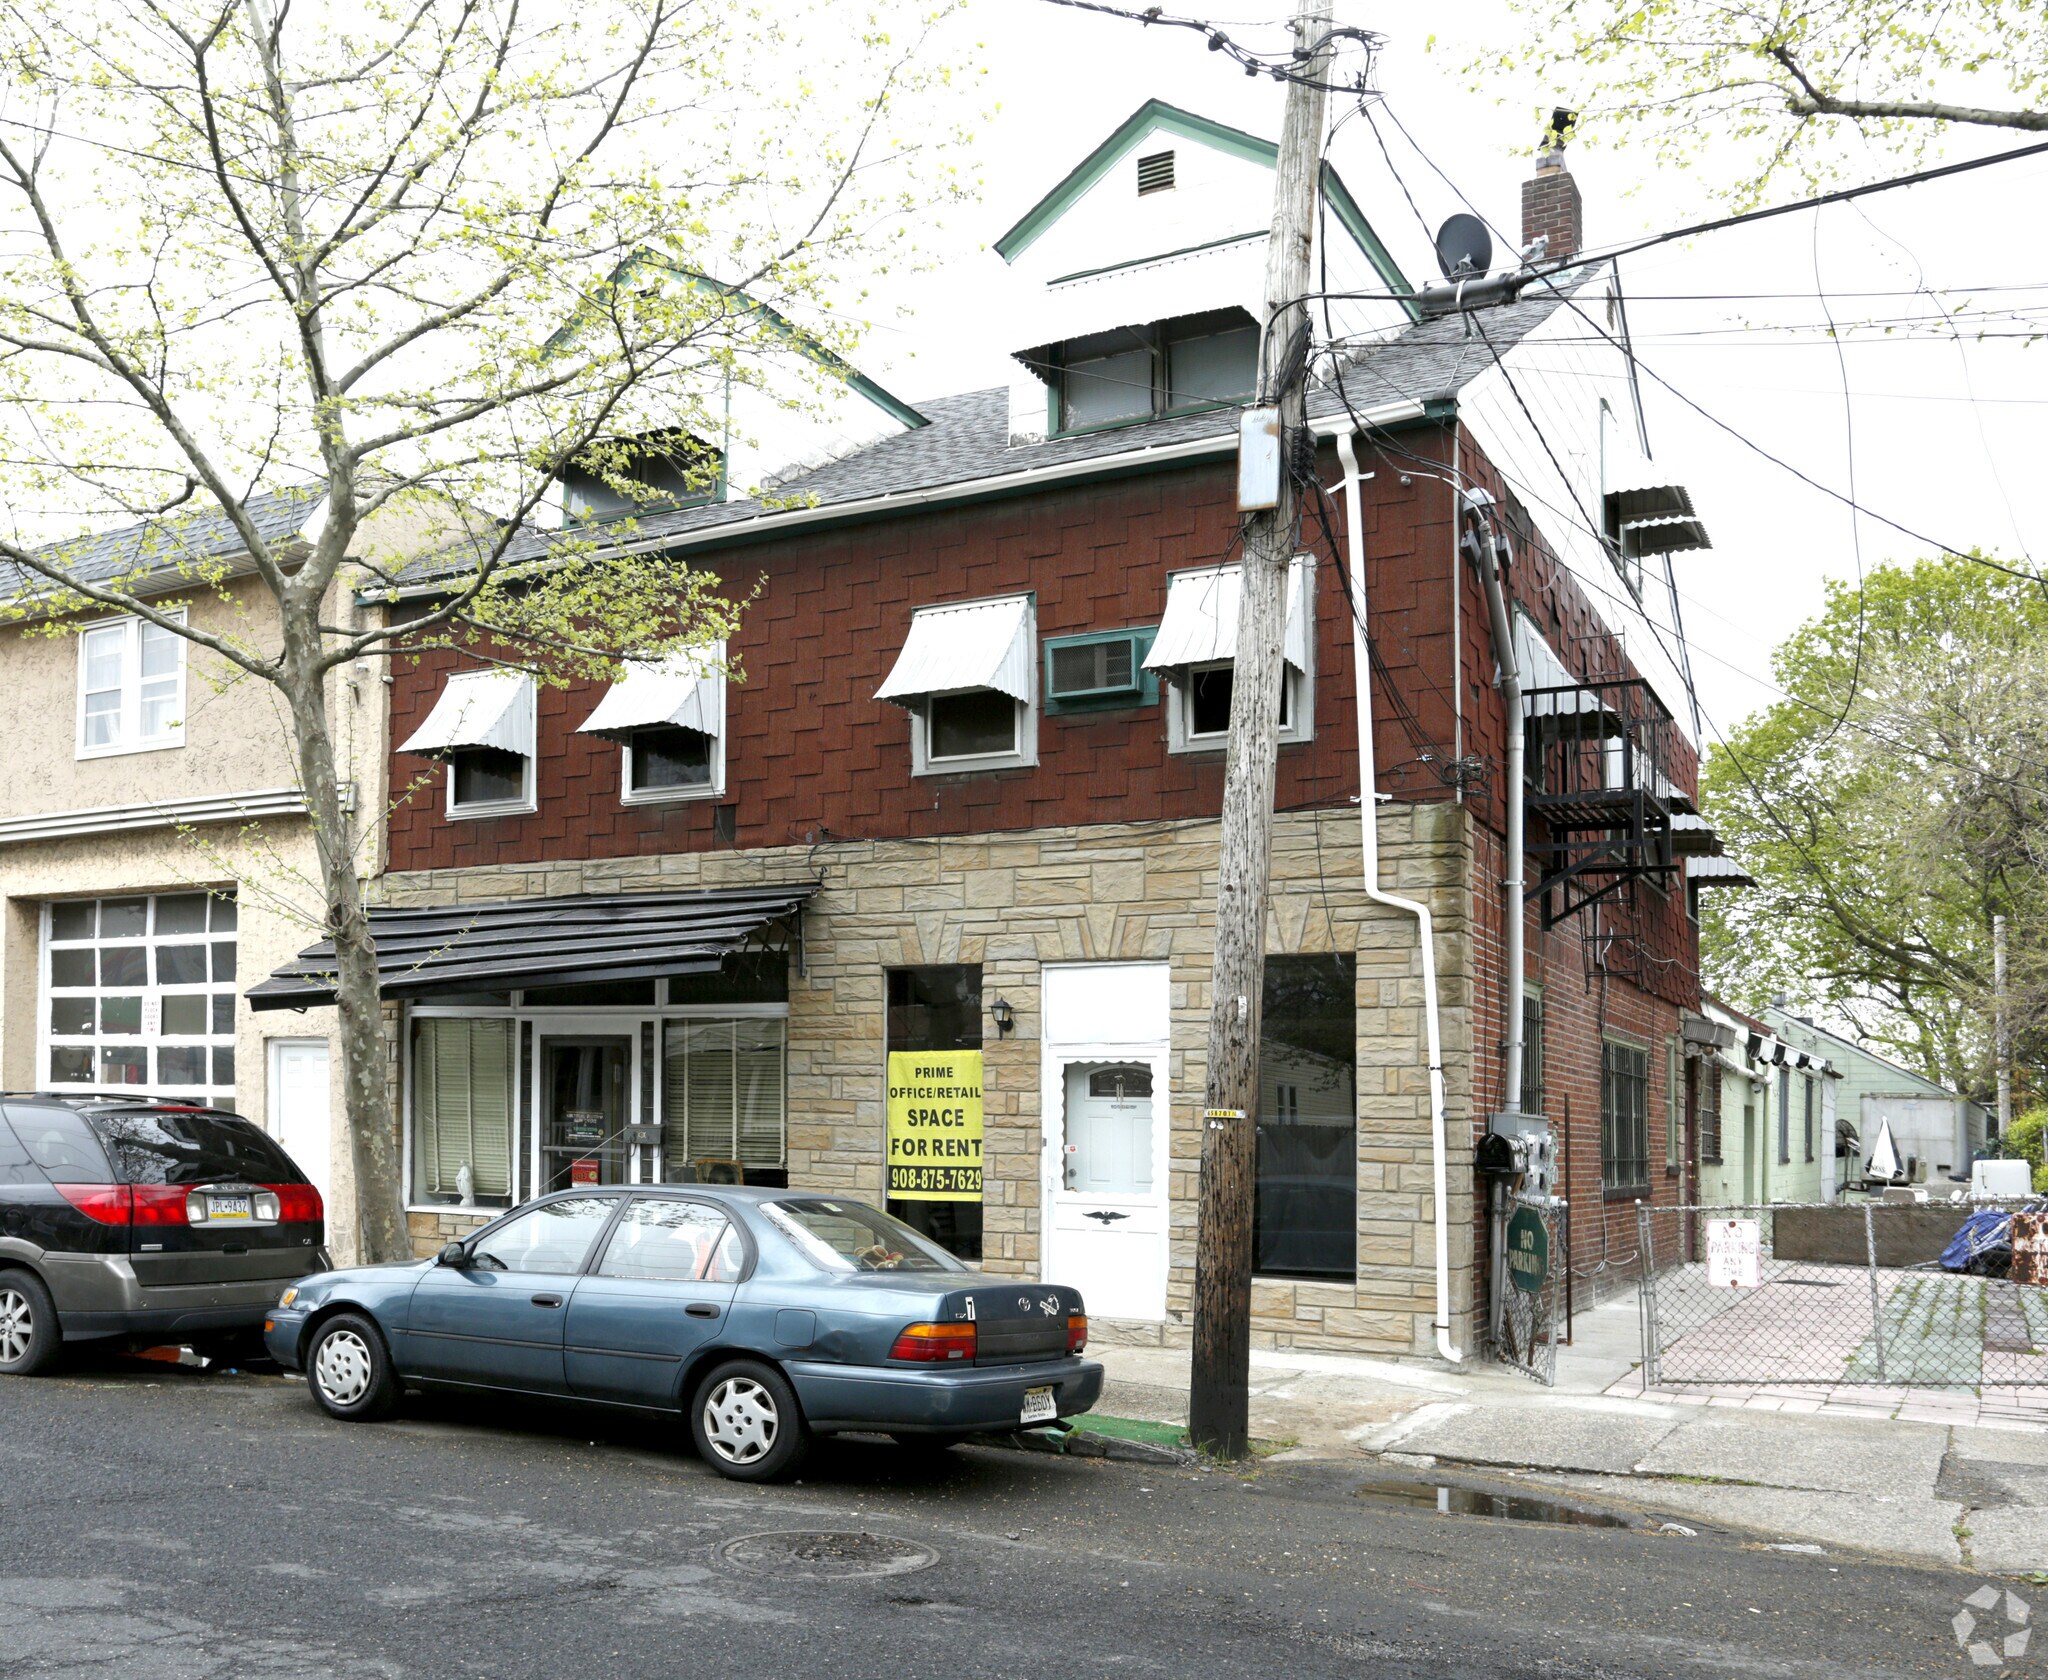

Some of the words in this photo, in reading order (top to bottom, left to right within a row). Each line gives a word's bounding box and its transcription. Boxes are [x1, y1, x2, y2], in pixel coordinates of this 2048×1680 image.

[915, 1067, 954, 1079] PRIME
[889, 1087, 982, 1099] OFFICE/RETAIL
[907, 1108, 965, 1127] SPACE
[891, 1138, 928, 1157] FOR
[932, 1138, 983, 1158] RENT
[892, 1168, 982, 1190] 908-875-7629
[1722, 1226, 1743, 1239] NO
[1520, 1229, 1534, 1250] NO
[1711, 1241, 1755, 1255] PARKING
[1723, 1257, 1742, 1265] ANY
[1722, 1267, 1743, 1277] TIME
